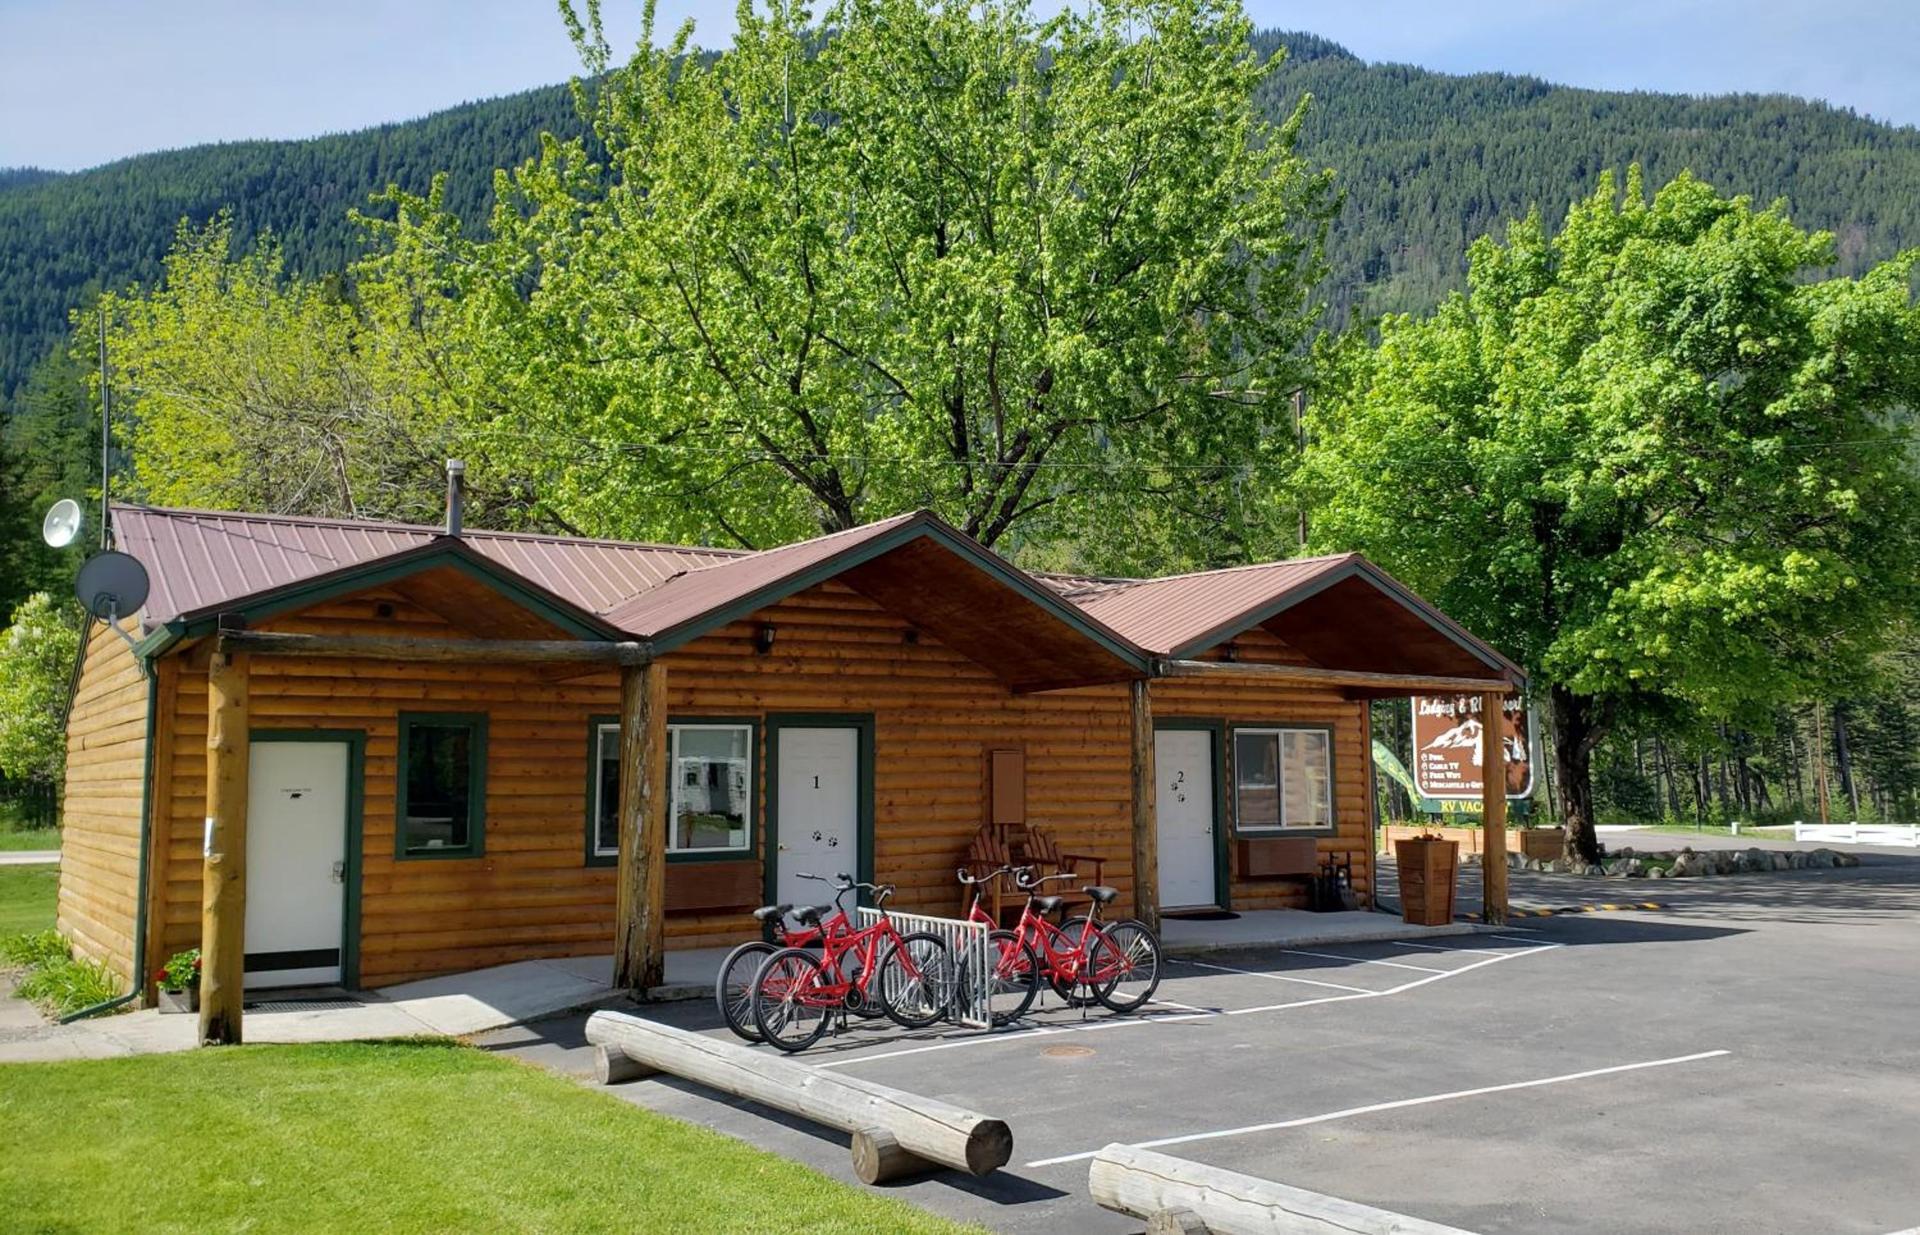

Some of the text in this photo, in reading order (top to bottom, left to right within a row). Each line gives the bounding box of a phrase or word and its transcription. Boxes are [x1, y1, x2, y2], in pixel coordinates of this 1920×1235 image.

[1420, 699, 1456, 717] Lodging
[1449, 762, 1460, 770] TV
[813, 775, 820, 789] 1
[1177, 771, 1184, 783] 2
[1441, 800, 1456, 812] RV
